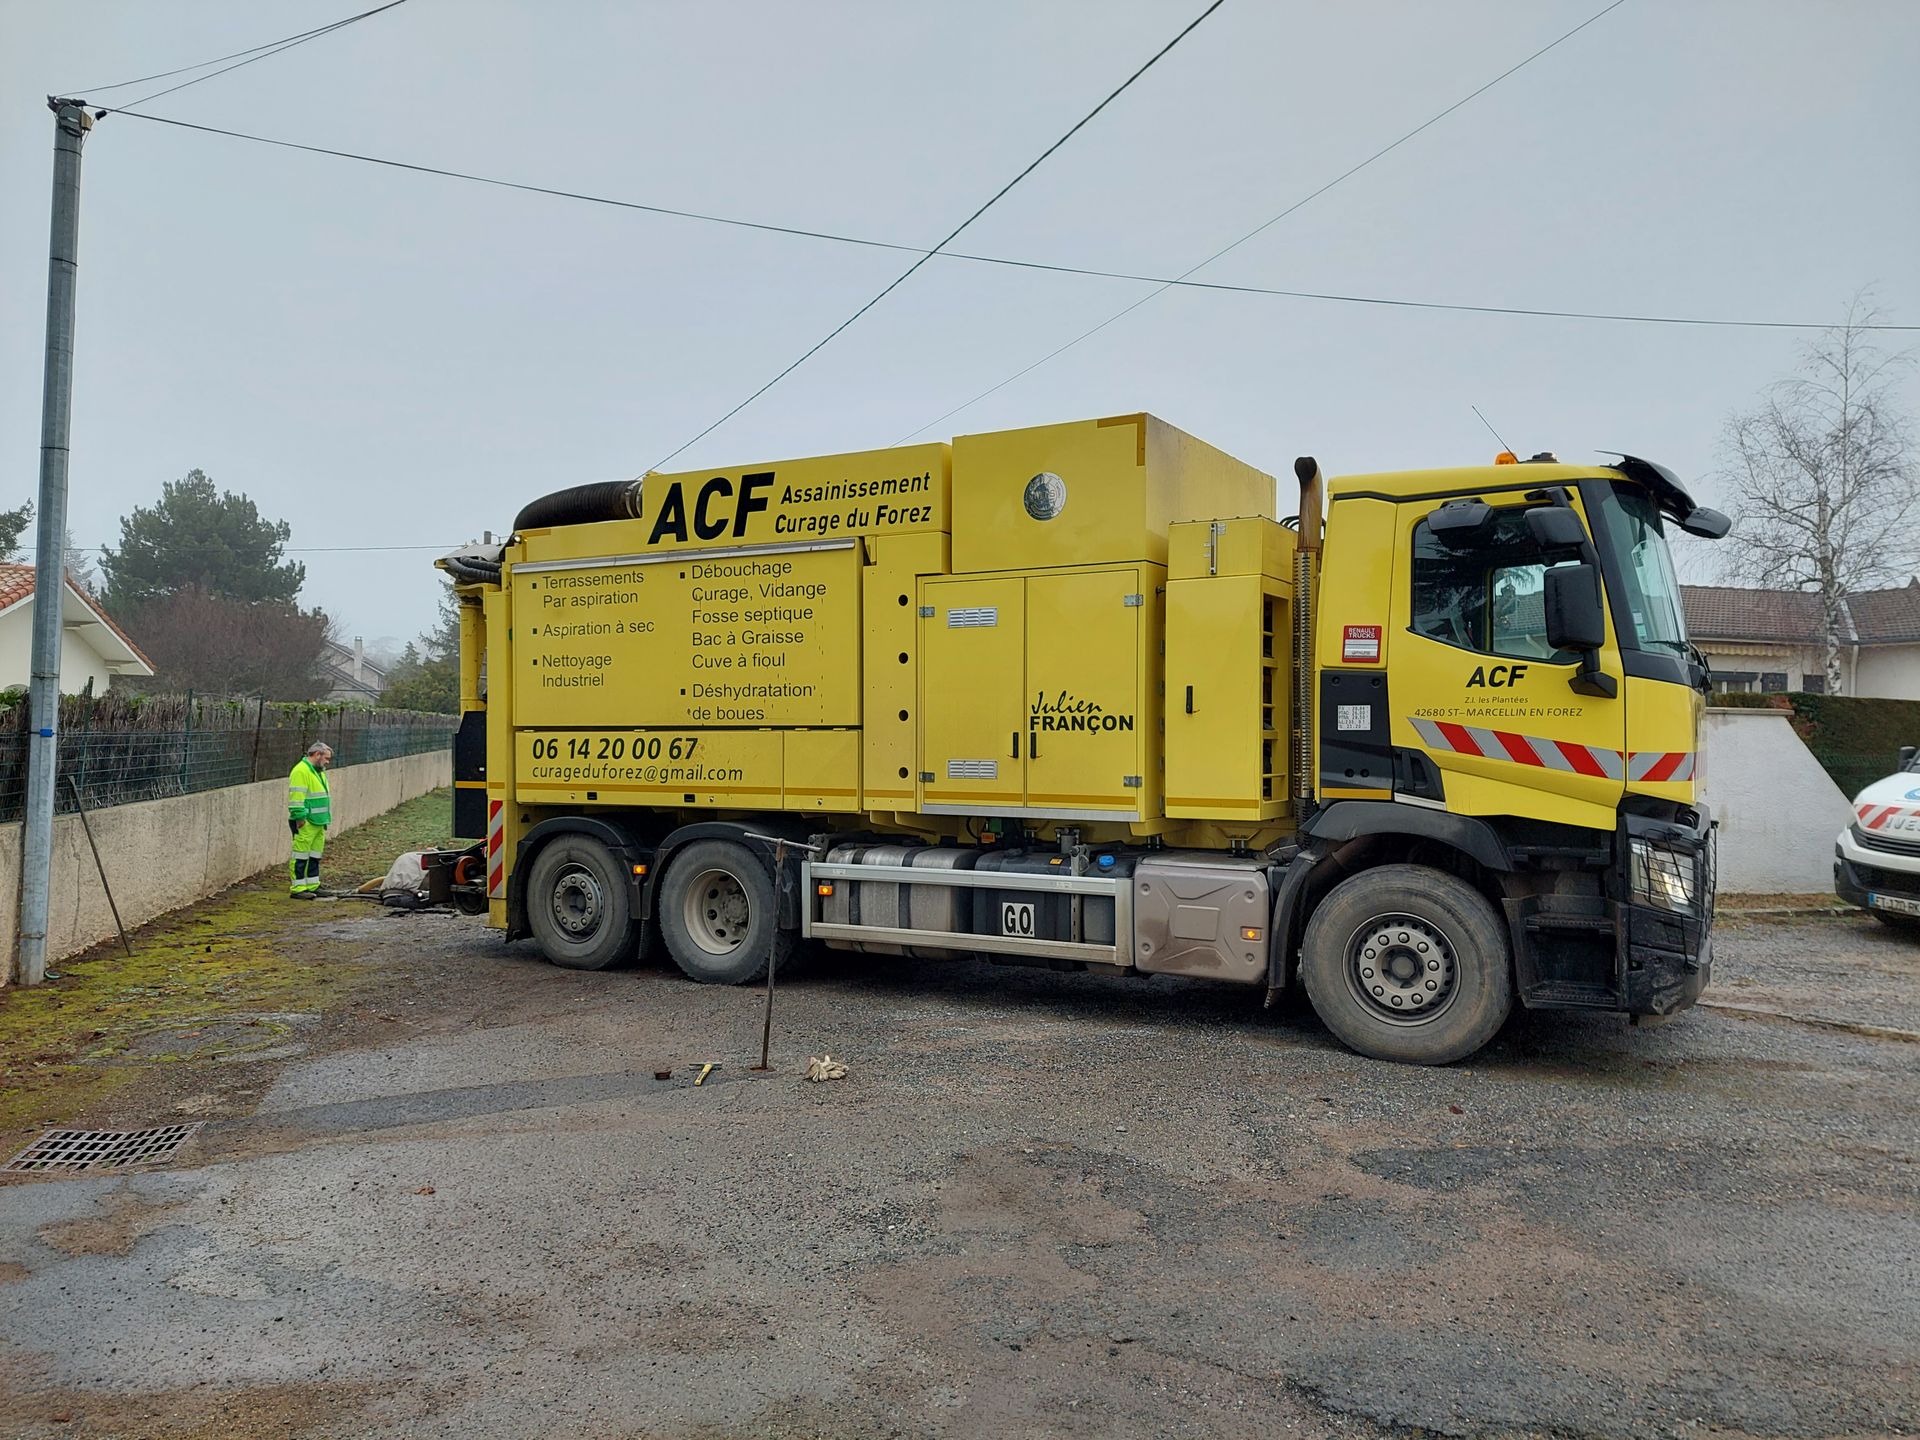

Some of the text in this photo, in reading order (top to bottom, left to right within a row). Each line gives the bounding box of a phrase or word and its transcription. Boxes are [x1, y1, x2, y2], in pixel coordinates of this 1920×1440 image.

[780, 472, 931, 505] Assainissement
[647, 471, 776, 545] ACF
[775, 505, 932, 536] Curage du Forez
[692, 561, 792, 578] Débouchage
[542, 570, 645, 589] Terrassements
[543, 590, 639, 609] Par aspiration
[692, 583, 827, 603] Curage, Vidange
[692, 606, 814, 624] Fosse septique
[542, 619, 655, 639] Aspiration à sec
[692, 629, 805, 646] Bac à Graisse
[542, 654, 612, 670] Nettoyage
[692, 652, 786, 669] Cuve à fioul
[542, 673, 604, 688] Industriel
[1465, 665, 1529, 688] ACF
[692, 683, 813, 701] Déshydratation
[1478, 696, 1490, 704] les
[1491, 696, 1529, 704] Plantées
[1031, 690, 1103, 714] Julien
[692, 706, 765, 720] de boues
[1414, 708, 1446, 717] 42680
[1530, 708, 1544, 717] EN
[1547, 708, 1583, 717] FOREZ
[1030, 715, 1134, 736] FRANÇON
[532, 737, 699, 760] 06 14 20 00 67
[532, 763, 743, 783] curageduforez@gmail.com
[1884, 816, 1920, 832] IVE
[1004, 904, 1033, 935] G.O.
